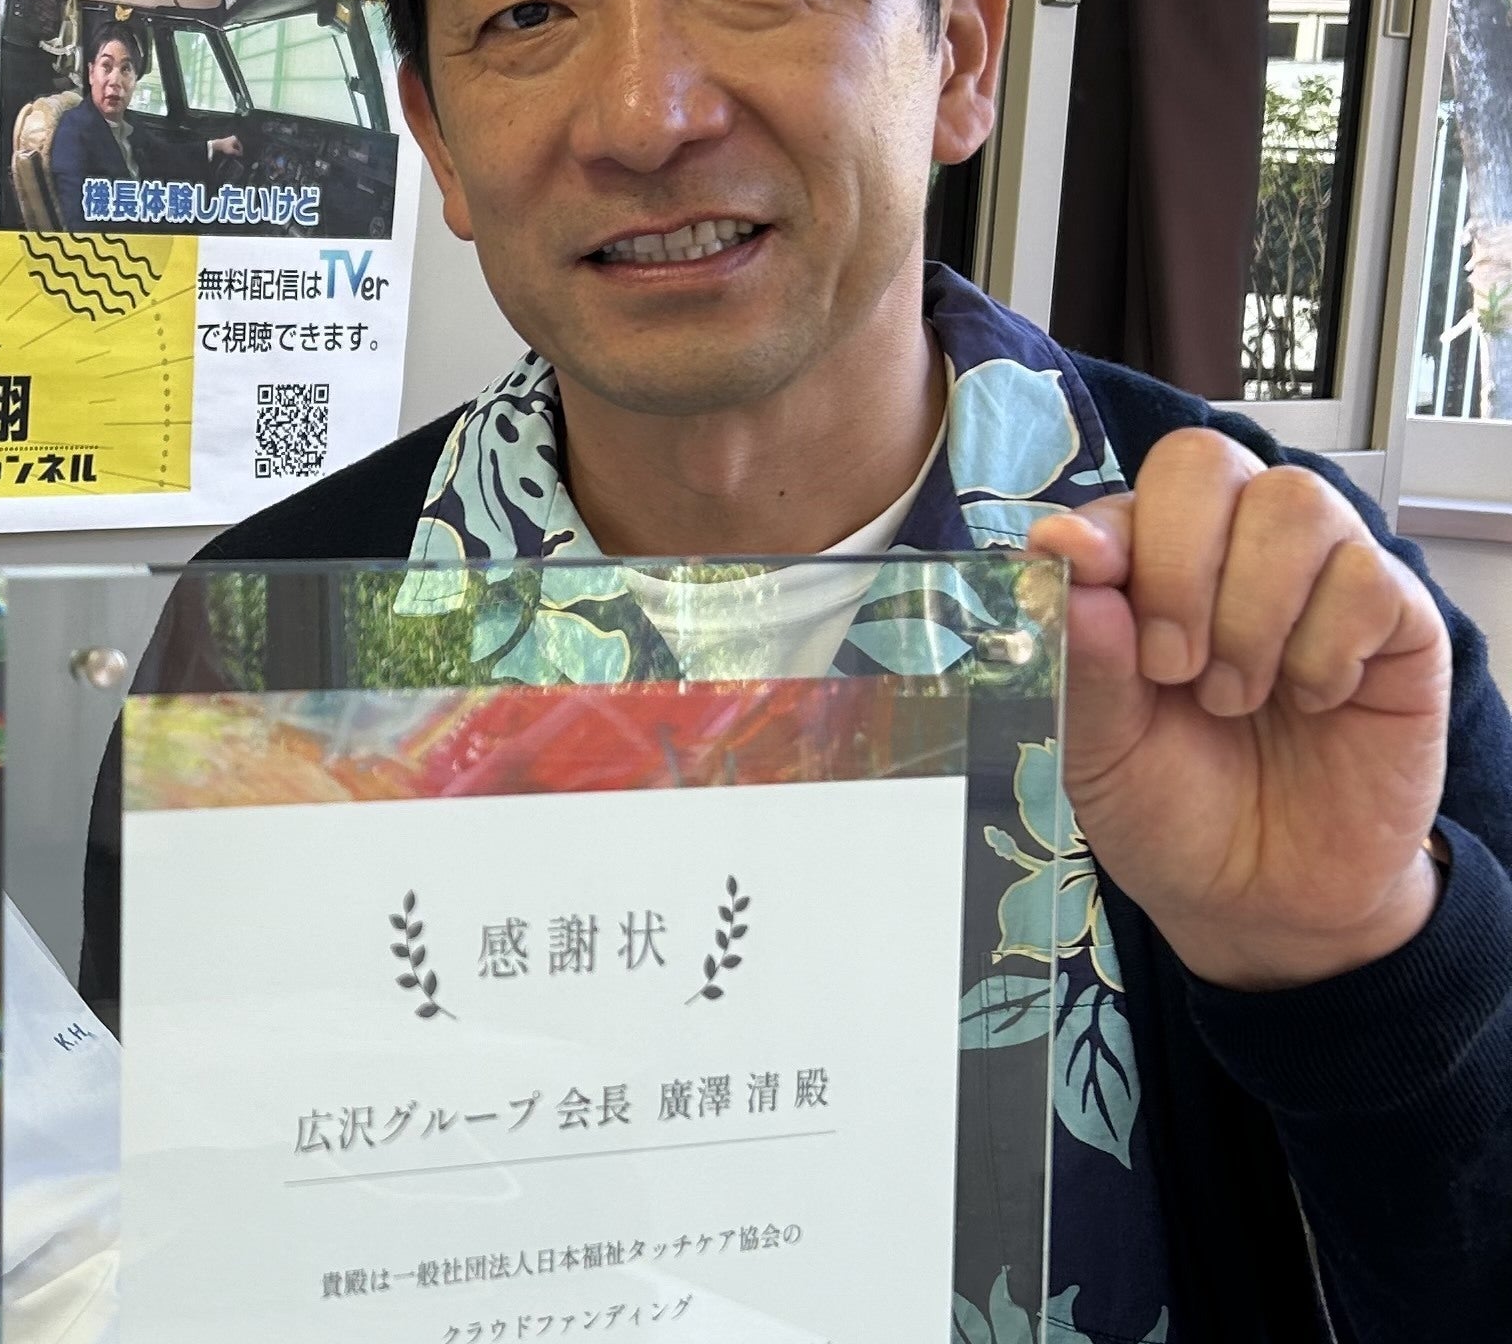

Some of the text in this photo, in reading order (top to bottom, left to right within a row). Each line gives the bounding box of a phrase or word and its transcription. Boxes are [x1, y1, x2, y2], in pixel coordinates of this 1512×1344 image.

[83, 179, 320, 226] 機長体験したいけど
[197, 321, 378, 353] で視聴できます。
[477, 910, 668, 979] 感謝状
[321, 1222, 802, 1299] 貴殿は一般社団法人日本福祉タッチケア協会の
